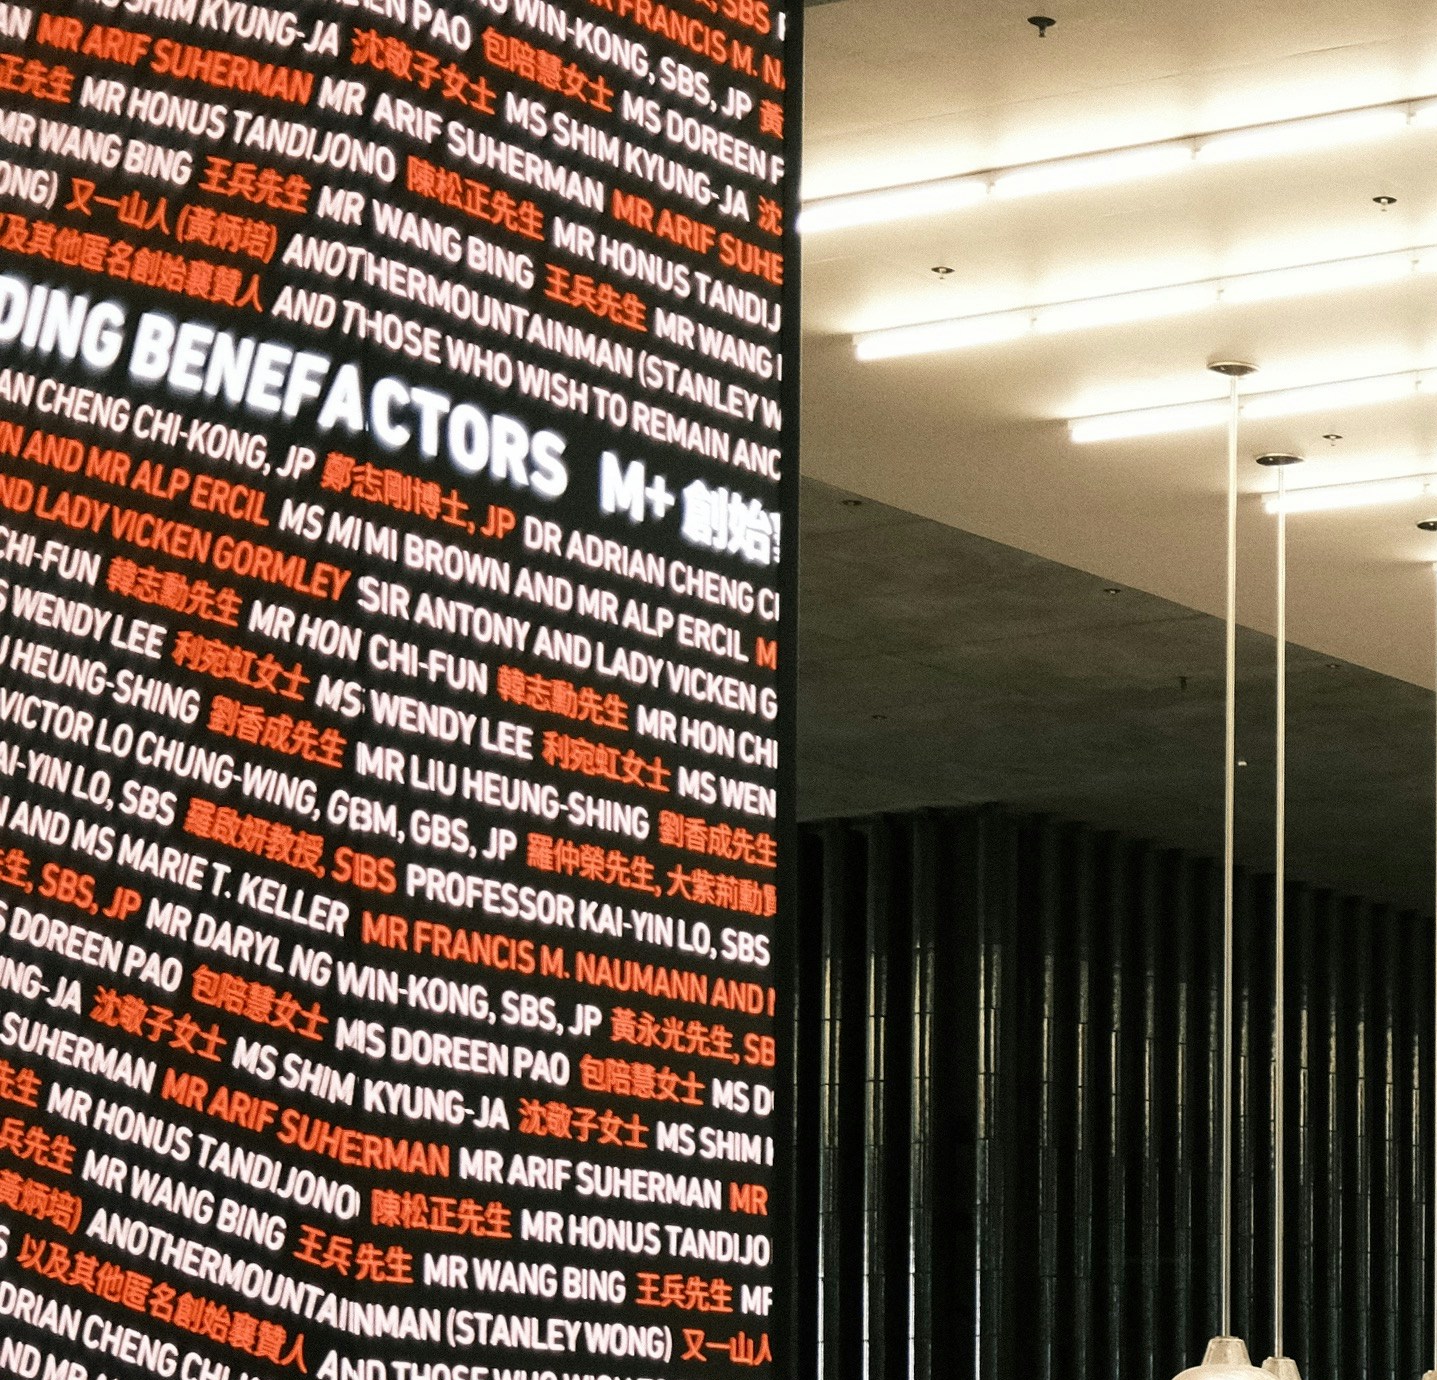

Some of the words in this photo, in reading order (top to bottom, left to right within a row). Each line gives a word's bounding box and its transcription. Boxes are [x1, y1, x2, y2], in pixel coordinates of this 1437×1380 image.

[318, 76, 366, 115] MR
[373, 93, 443, 143] ARIF
[447, 121, 604, 212] SUHERMAN
[612, 189, 654, 232] MR
[656, 209, 716, 254] ARIF
[412, 0, 471, 52] PAO
[622, 90, 663, 135] MS
[666, 109, 768, 180] DOREEN
[39, 118, 121, 169] WANG
[123, 140, 193, 186] BING
[199, 156, 311, 213] 王兵先生
[317, 186, 365, 225] MR
[373, 199, 462, 263] WANG
[466, 236, 534, 290] BING
[545, 264, 647, 332] 王兵先生
[655, 307, 694, 350] MR
[697, 323, 773, 378] WANG
[65, 178, 170, 235] 又一山人
[638, 350, 758, 421] (STANLEY
[129, 313, 568, 497] BENEFACTORS
[600, 451, 675, 523] M+
[272, 286, 335, 329] AND
[342, 300, 441, 364] THOSE
[446, 335, 514, 388] WHO
[517, 360, 588, 414] WISH
[592, 387, 628, 427] TO
[631, 401, 729, 462] REMAIN
[36, 379, 129, 433] CHENG
[133, 405, 270, 476] CHI-KONG,
[276, 445, 316, 479] JP
[480, 505, 516, 539] JP
[524, 516, 562, 556] DR
[566, 530, 665, 587] ADRIAN
[668, 561, 754, 614] CHENG
[12, 585, 111, 641] WENDY
[111, 615, 167, 659] LEE
[370, 690, 477, 745] WENDY
[480, 717, 533, 760] LEE
[678, 766, 717, 804] MS
[12, 639, 200, 724] HEUNG-SHING
[207, 695, 345, 768] 劉香成先生
[410, 755, 457, 796] LIU
[462, 767, 650, 840] HEUNG-SHING
[95, 718, 133, 757] LO
[136, 731, 320, 821] CHUNG-WING,
[410, 810, 477, 859] GBS,
[482, 827, 517, 860] JP
[10, 801, 70, 845] AND
[73, 819, 115, 861] MS
[117, 834, 207, 890] MARIE
[212, 862, 231, 898] T.
[238, 872, 349, 937] KELLER
[362, 911, 408, 951] MR
[414, 921, 535, 974] FRANCIS
[540, 945, 570, 978] M.
[576, 951, 707, 1004] NAUMANN
[710, 978, 760, 1014] AND
[10, 907, 122, 972] DOREEN
[123, 945, 182, 992] PAO
[391, 1027, 508, 1076] DOREEN
[513, 1047, 570, 1086] PAO
[712, 1078, 750, 1113] MS
[232, 1037, 278, 1080] MS
[364, 1079, 510, 1130] KYUNG-JA
[657, 1121, 695, 1156] MS
[699, 1127, 759, 1164] SHIM
[82, 1149, 127, 1193] MR
[131, 1166, 215, 1224] WANG
[218, 1198, 287, 1250] BING
[294, 1225, 413, 1283] 王兵先生
[424, 1253, 468, 1289] MR
[473, 1258, 557, 1297] WANG
[563, 1266, 626, 1304] BING
[636, 1273, 733, 1312] 王兵先生
